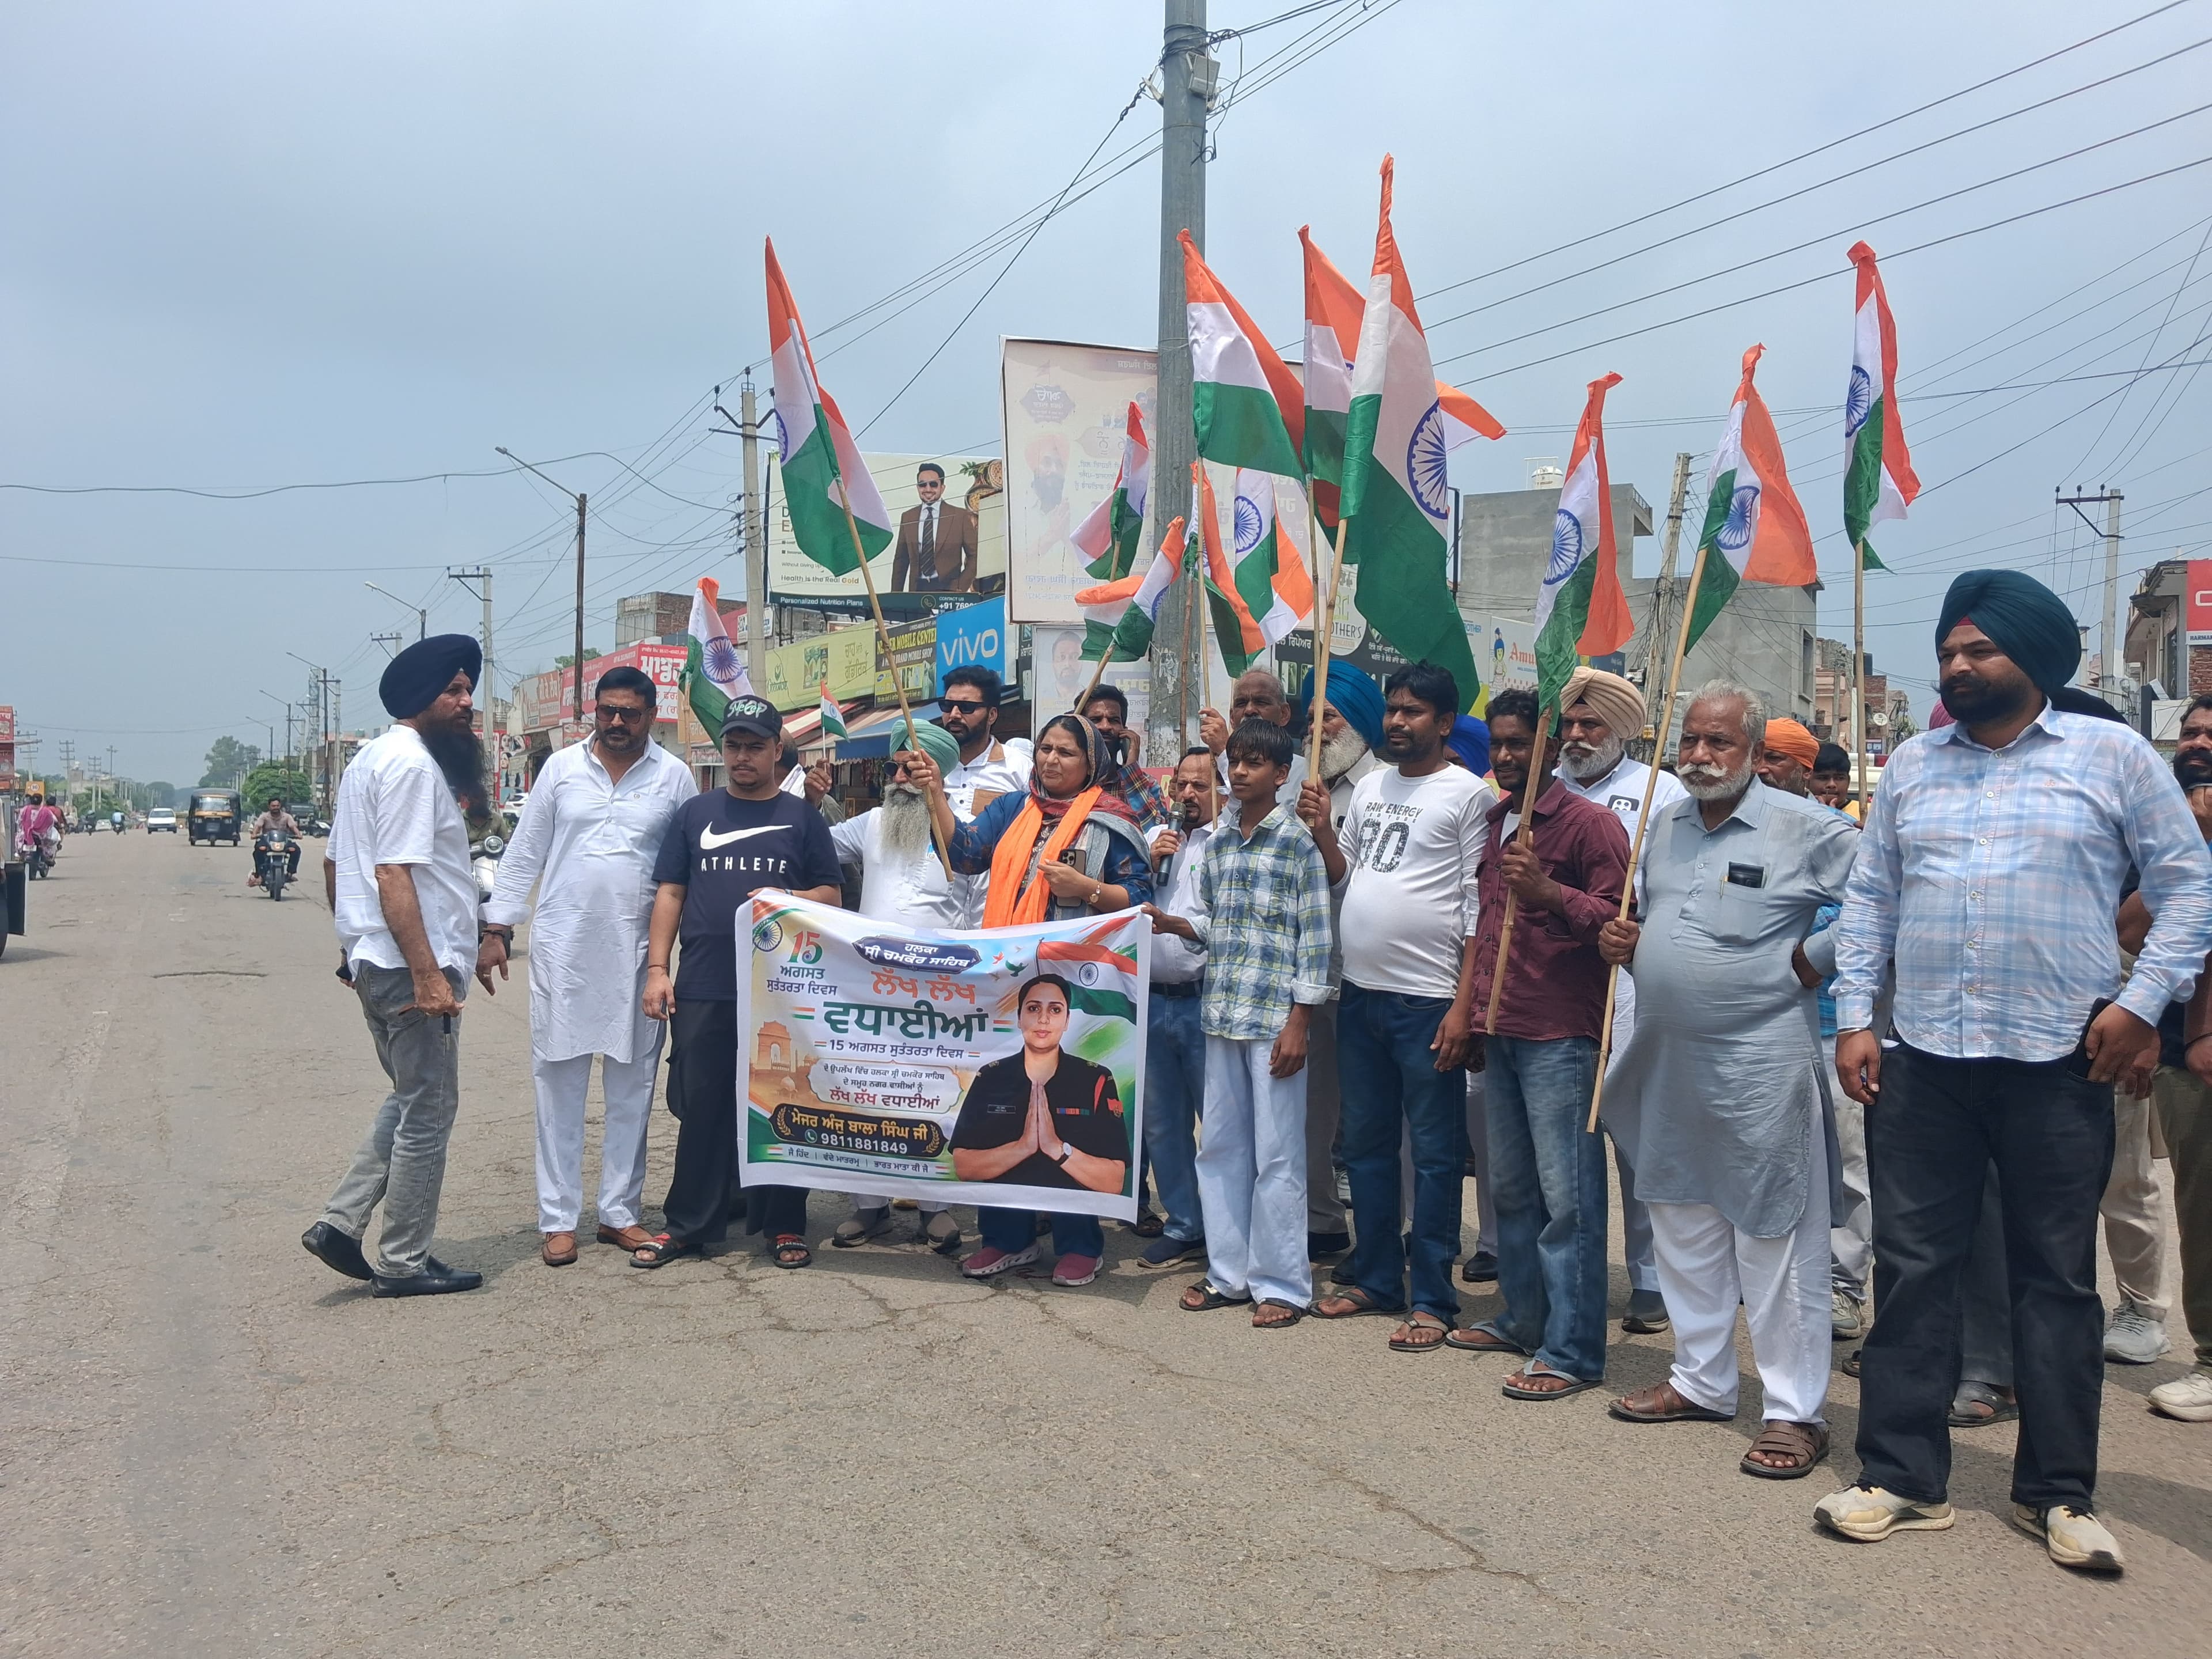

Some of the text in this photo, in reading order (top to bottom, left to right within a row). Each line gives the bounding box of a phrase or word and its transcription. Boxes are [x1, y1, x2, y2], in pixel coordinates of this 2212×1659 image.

[781, 597, 819, 605] Personalized
[896, 631, 916, 650] MOBILE
[941, 627, 998, 666] vivo
[922, 647, 933, 660] SHOP
[1365, 801, 1423, 818] RAW ENERGY
[701, 856, 787, 873] ATHLETE
[787, 930, 823, 965] 15
[905, 943, 938, 954] ਹਲਕਾ
[929, 956, 971, 968] ਸਾਹਿਬ
[780, 965, 825, 979] ਅਗਸਤ
[767, 978, 838, 995] ਸੁਤੰਤਰਤਾ ਦਿਵਸ
[871, 967, 976, 1005] ਲੱਖ ਲੱਖ
[823, 999, 990, 1042] ਵਧਾਈਆਂ
[830, 1039, 964, 1059] 15 ਅਗਸਤ ਸੁਤੰਤਰਤਾ ਦਿਵਸ
[843, 1077, 849, 1086] ਦੇ
[855, 1066, 869, 1075] ਵਿੱਚ
[871, 1069, 889, 1077] ਹਲਕਾ
[925, 1071, 945, 1081] ਸਾਹਿਬ
[830, 1085, 940, 1110] ਲੱਖ ਲੱਖ ਵਧਾਈਆਂ
[791, 1108, 819, 1127] ਮੇਜਰ
[848, 1120, 878, 1135] ਬਾਲਾ
[881, 1119, 910, 1139] ਸਿੰਘ
[913, 1123, 928, 1142] ਜੀ
[821, 1133, 908, 1154] 9811881849
[873, 1160, 892, 1169] ਭਾਰਤ
[894, 1162, 909, 1171] ਮਾਤਾ
[911, 1163, 921, 1173] ਕੀ
